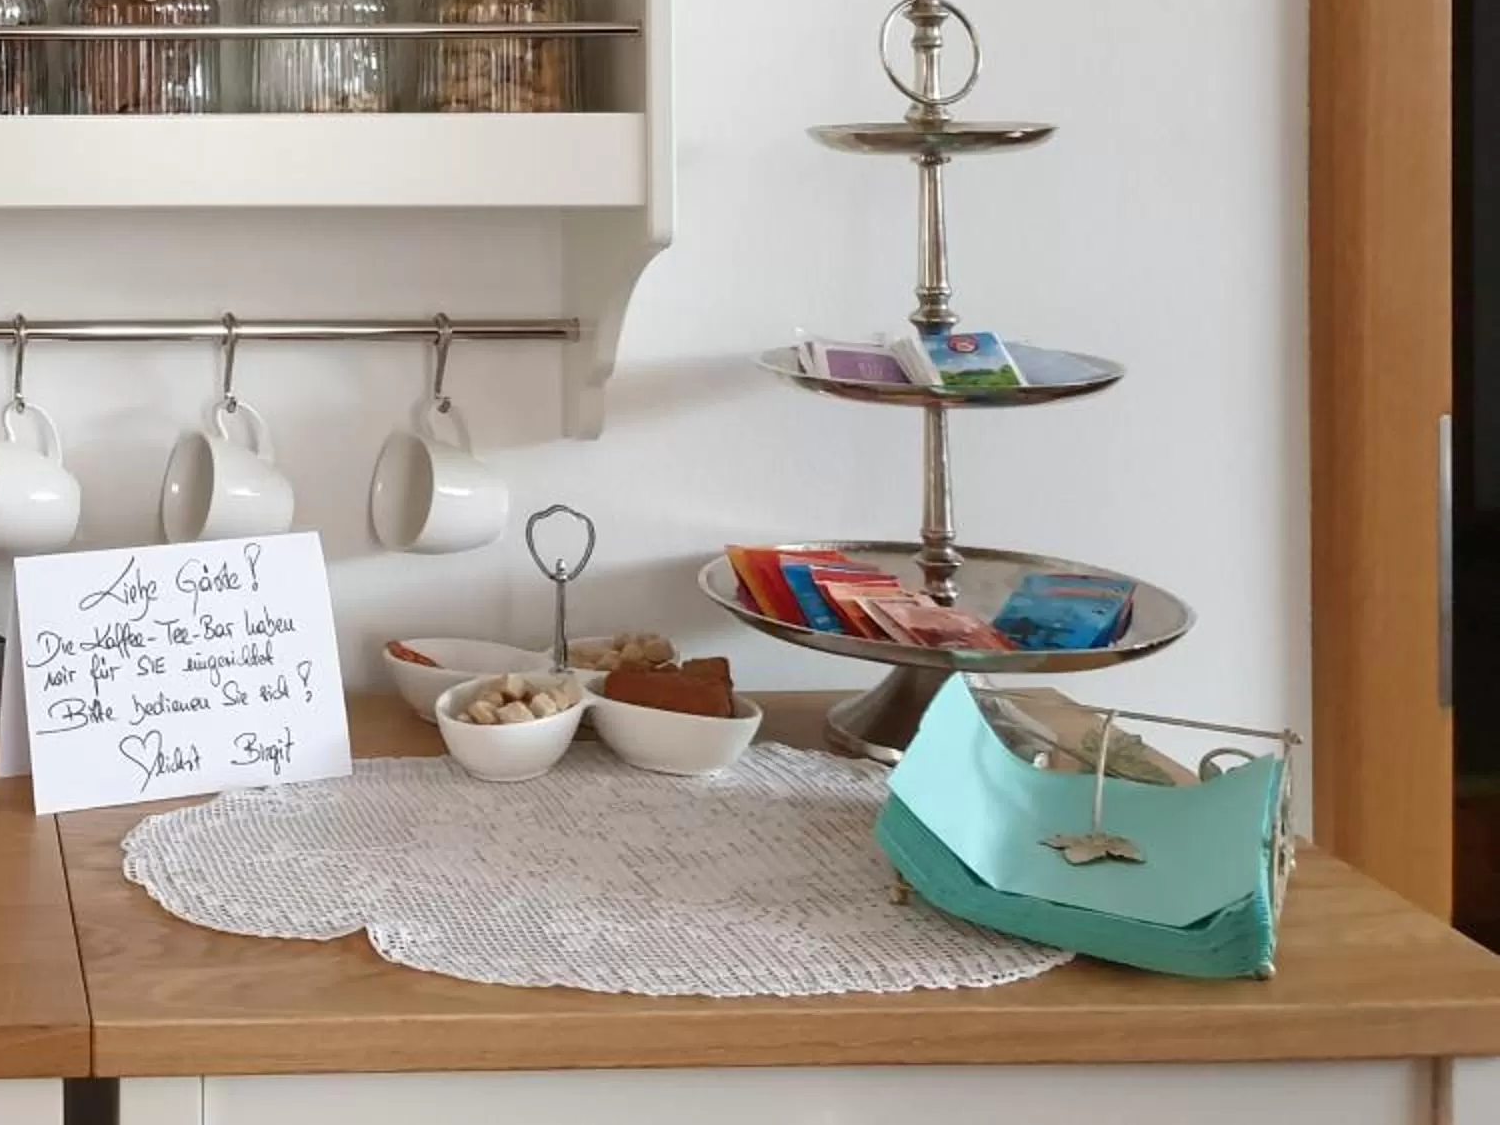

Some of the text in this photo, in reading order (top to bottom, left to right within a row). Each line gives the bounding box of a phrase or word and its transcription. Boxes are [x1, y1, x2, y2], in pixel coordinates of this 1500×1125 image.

[25, 630, 77, 668] Die
[244, 605, 297, 638] haben
[90, 653, 121, 697] für
[35, 697, 119, 736] Bitte
[128, 690, 212, 726] bedienen
[222, 679, 250, 706] Sie
[230, 725, 296, 776] Birgit
